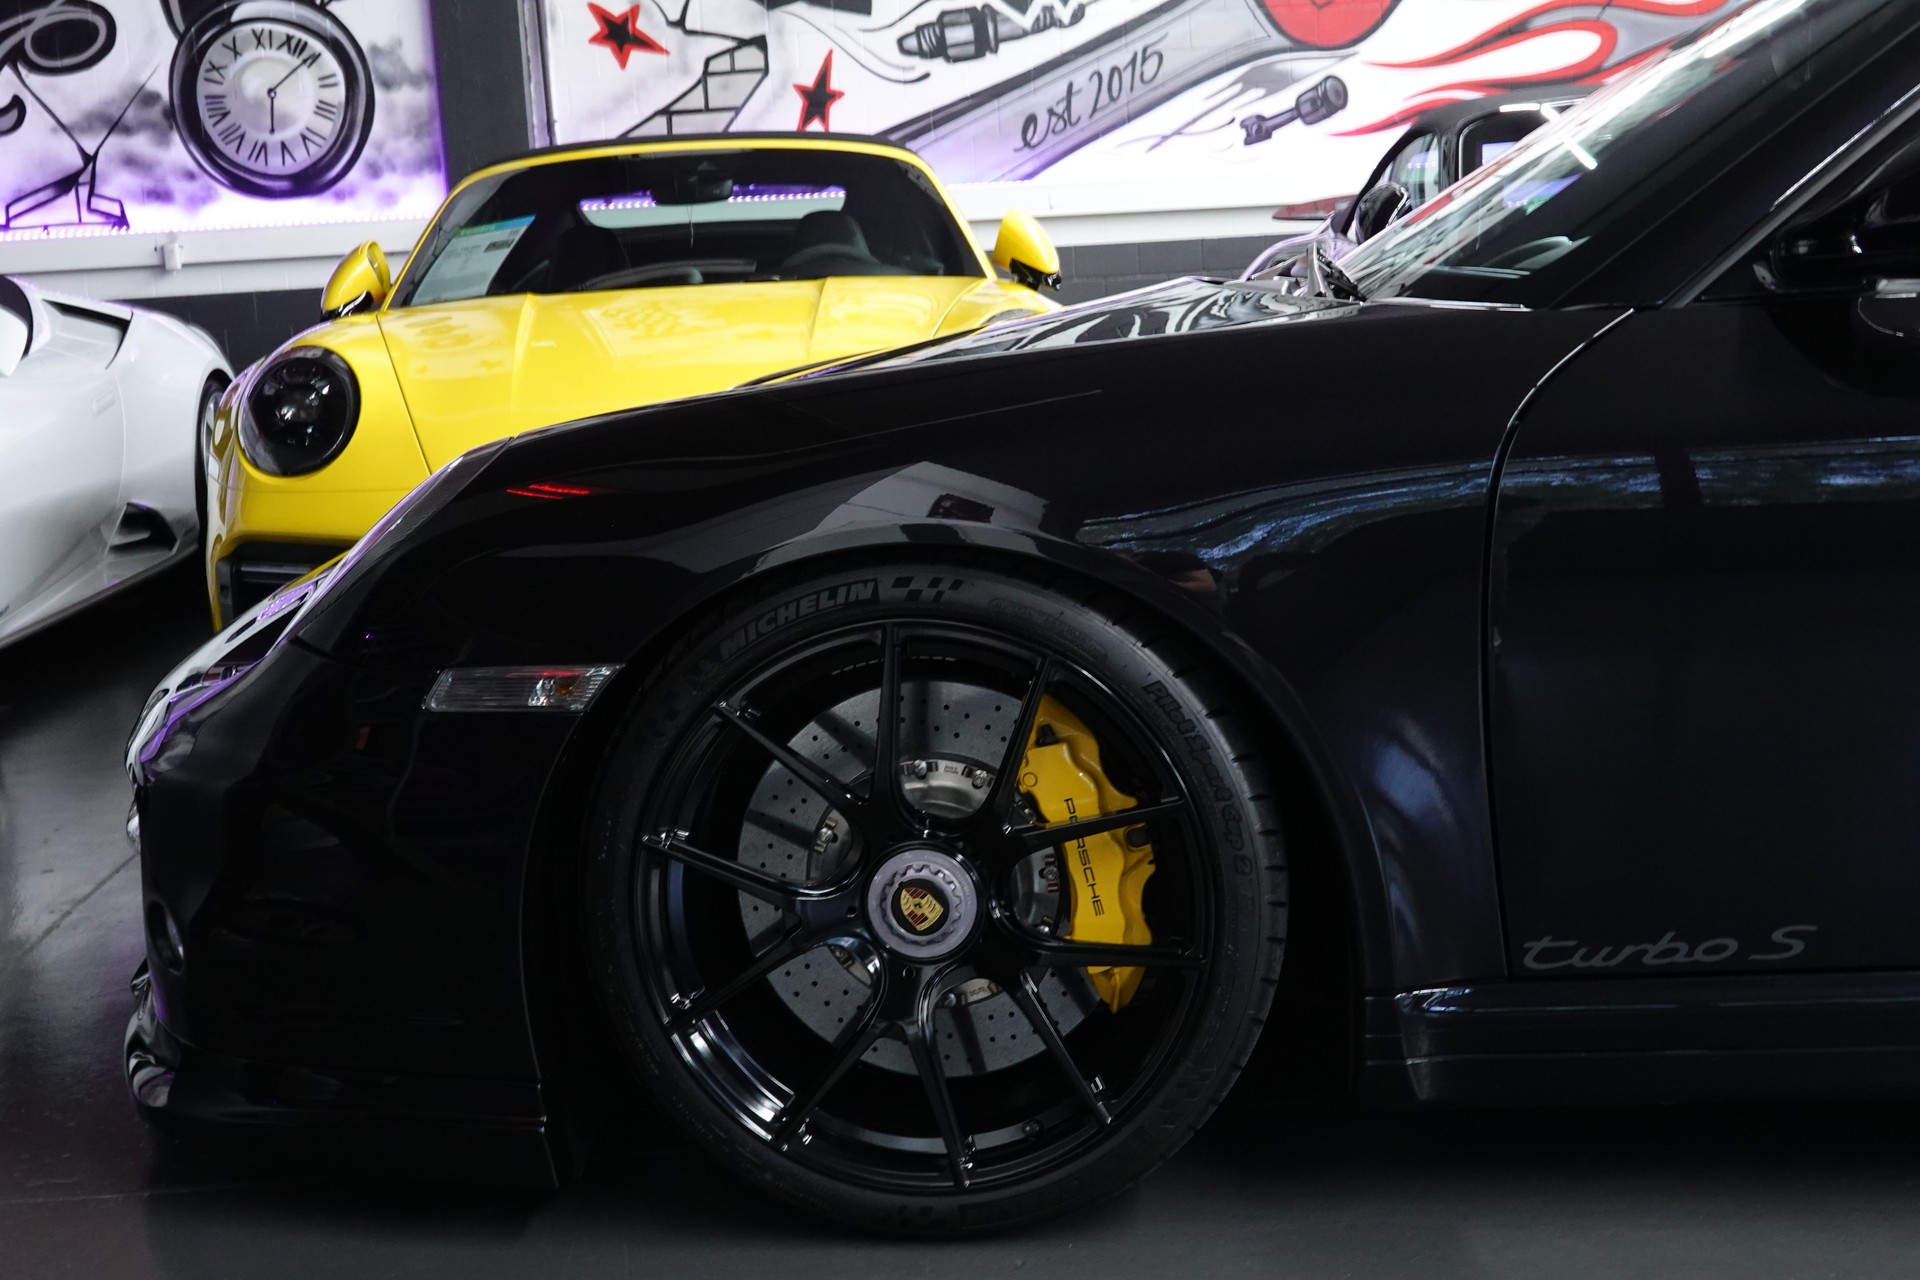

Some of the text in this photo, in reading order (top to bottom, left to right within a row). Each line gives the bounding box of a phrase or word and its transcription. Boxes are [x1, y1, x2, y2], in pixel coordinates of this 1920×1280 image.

[1013, 31, 1168, 152] est 2015
[719, 579, 877, 661] MICHELIN
[1522, 925, 1819, 970] turbo S
